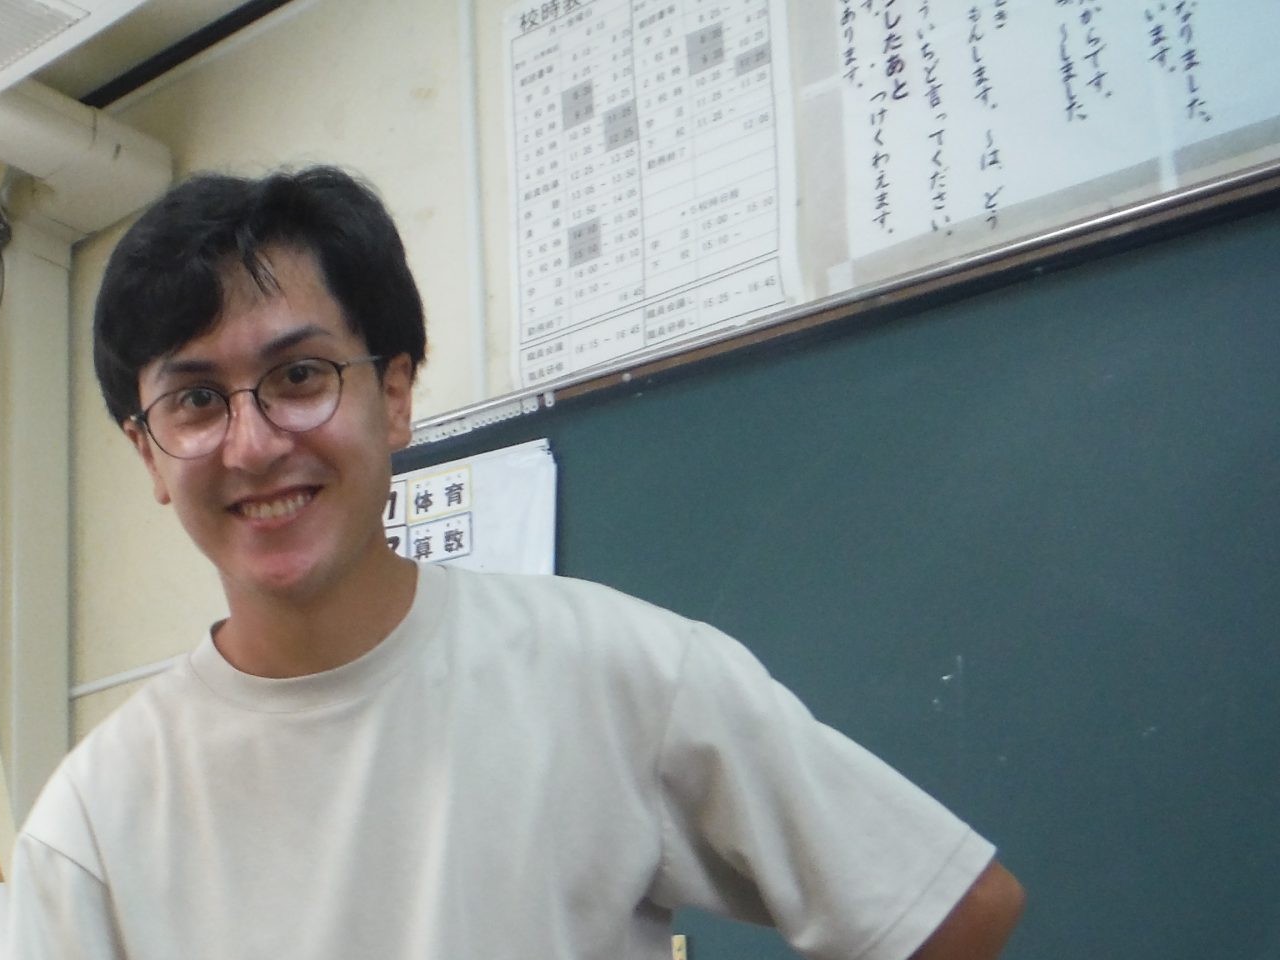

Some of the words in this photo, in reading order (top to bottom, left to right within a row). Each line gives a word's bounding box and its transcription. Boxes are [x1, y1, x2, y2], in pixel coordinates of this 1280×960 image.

[883, 0, 909, 100] したあと
[414, 483, 464, 515] 体育
[412, 528, 465, 560] 算数
